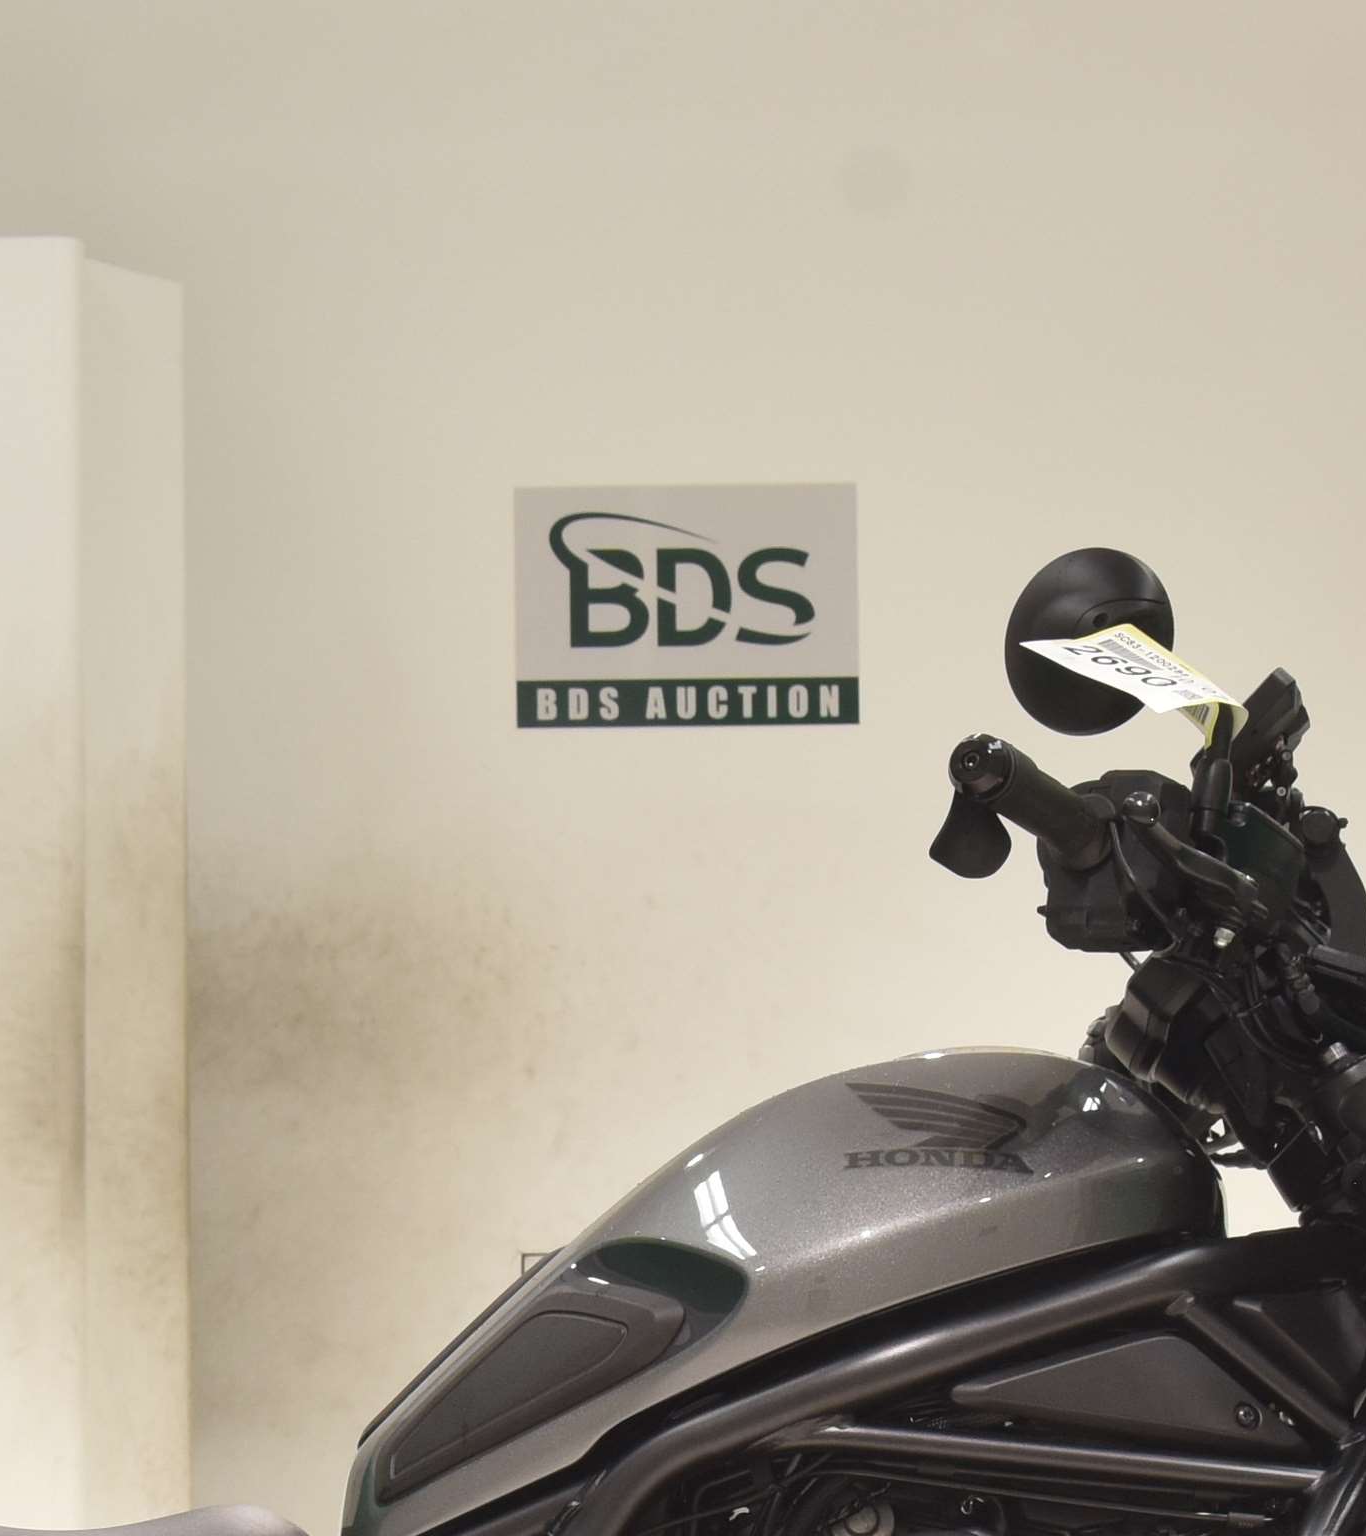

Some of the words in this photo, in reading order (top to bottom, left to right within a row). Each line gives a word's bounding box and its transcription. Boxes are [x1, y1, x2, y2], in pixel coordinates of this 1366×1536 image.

[549, 512, 816, 648] BDS
[1062, 645, 1178, 688] 2690
[536, 688, 620, 721] BDS
[645, 684, 841, 720] AUCTION
[843, 1149, 1035, 1185] HONDA
